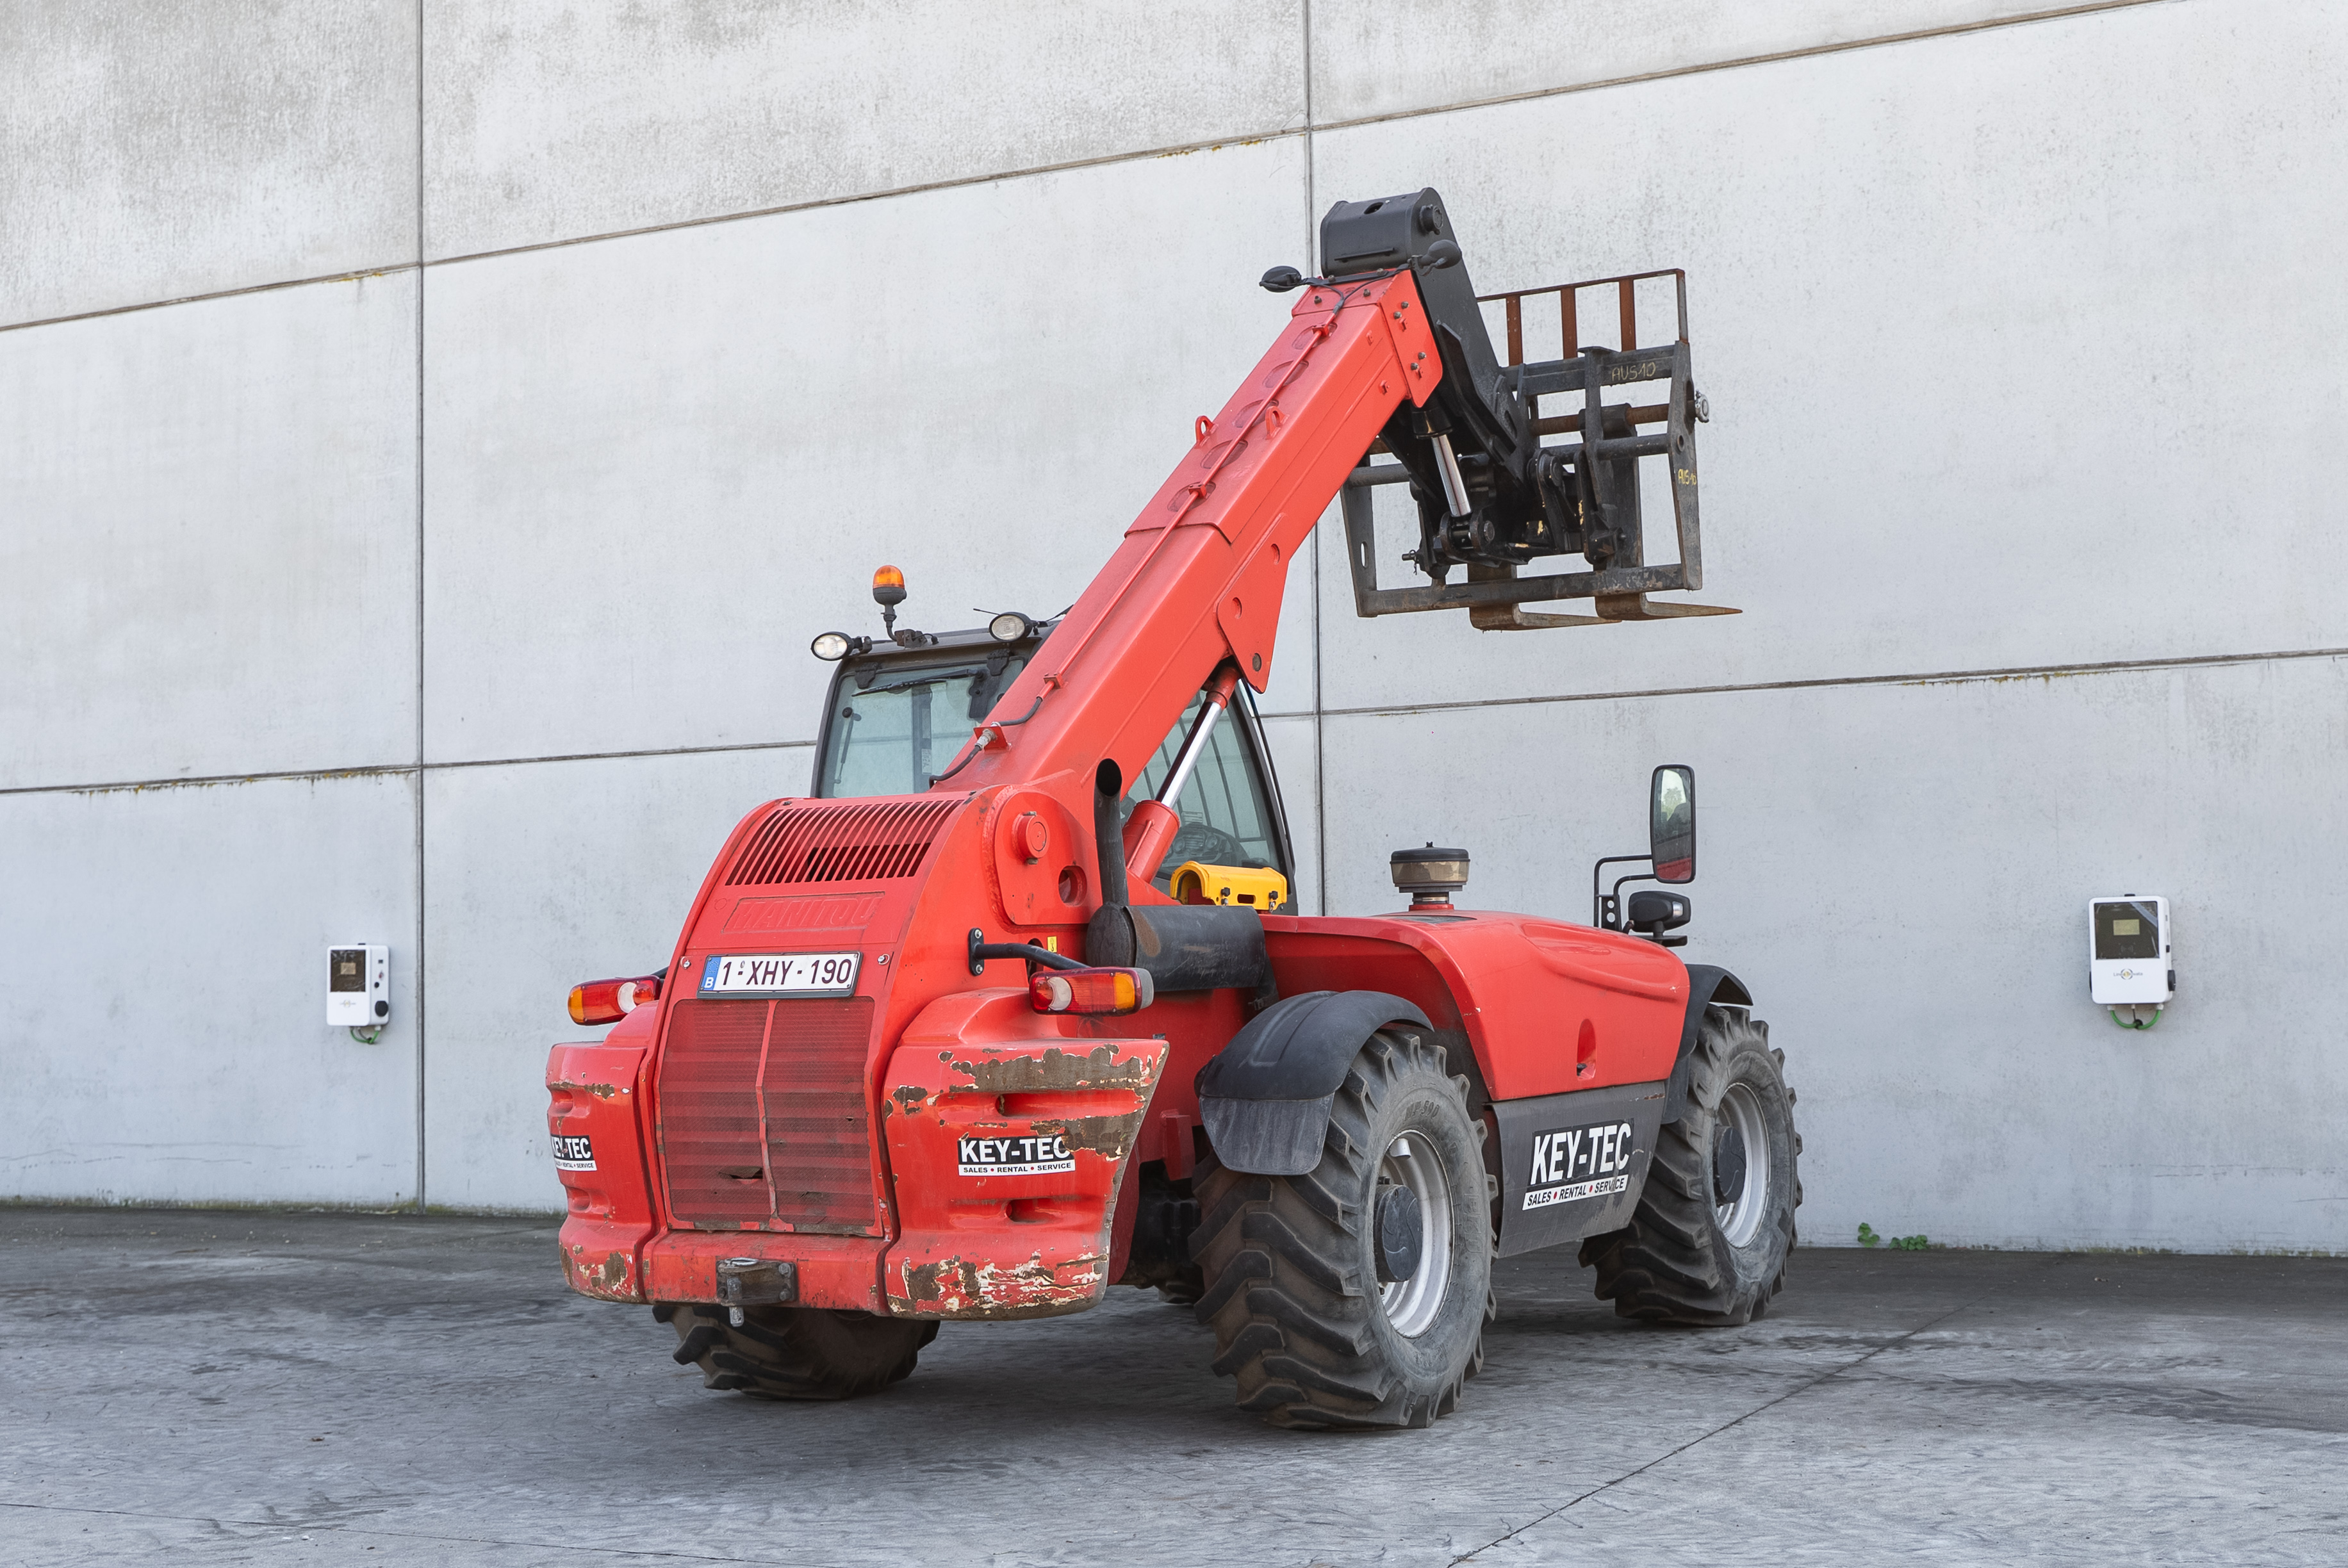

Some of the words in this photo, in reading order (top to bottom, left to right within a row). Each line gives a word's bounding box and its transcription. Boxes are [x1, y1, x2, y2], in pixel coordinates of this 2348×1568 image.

[725, 897, 884, 929] MANITOU
[704, 977, 714, 988] B
[960, 1136, 1071, 1163] KEY-TEC
[1530, 1122, 1632, 1186] KEY-TEC
[1037, 1162, 1071, 1172] SERVICE
[1527, 1191, 1552, 1207] SALES
[1559, 1184, 1586, 1200] RENTAL
